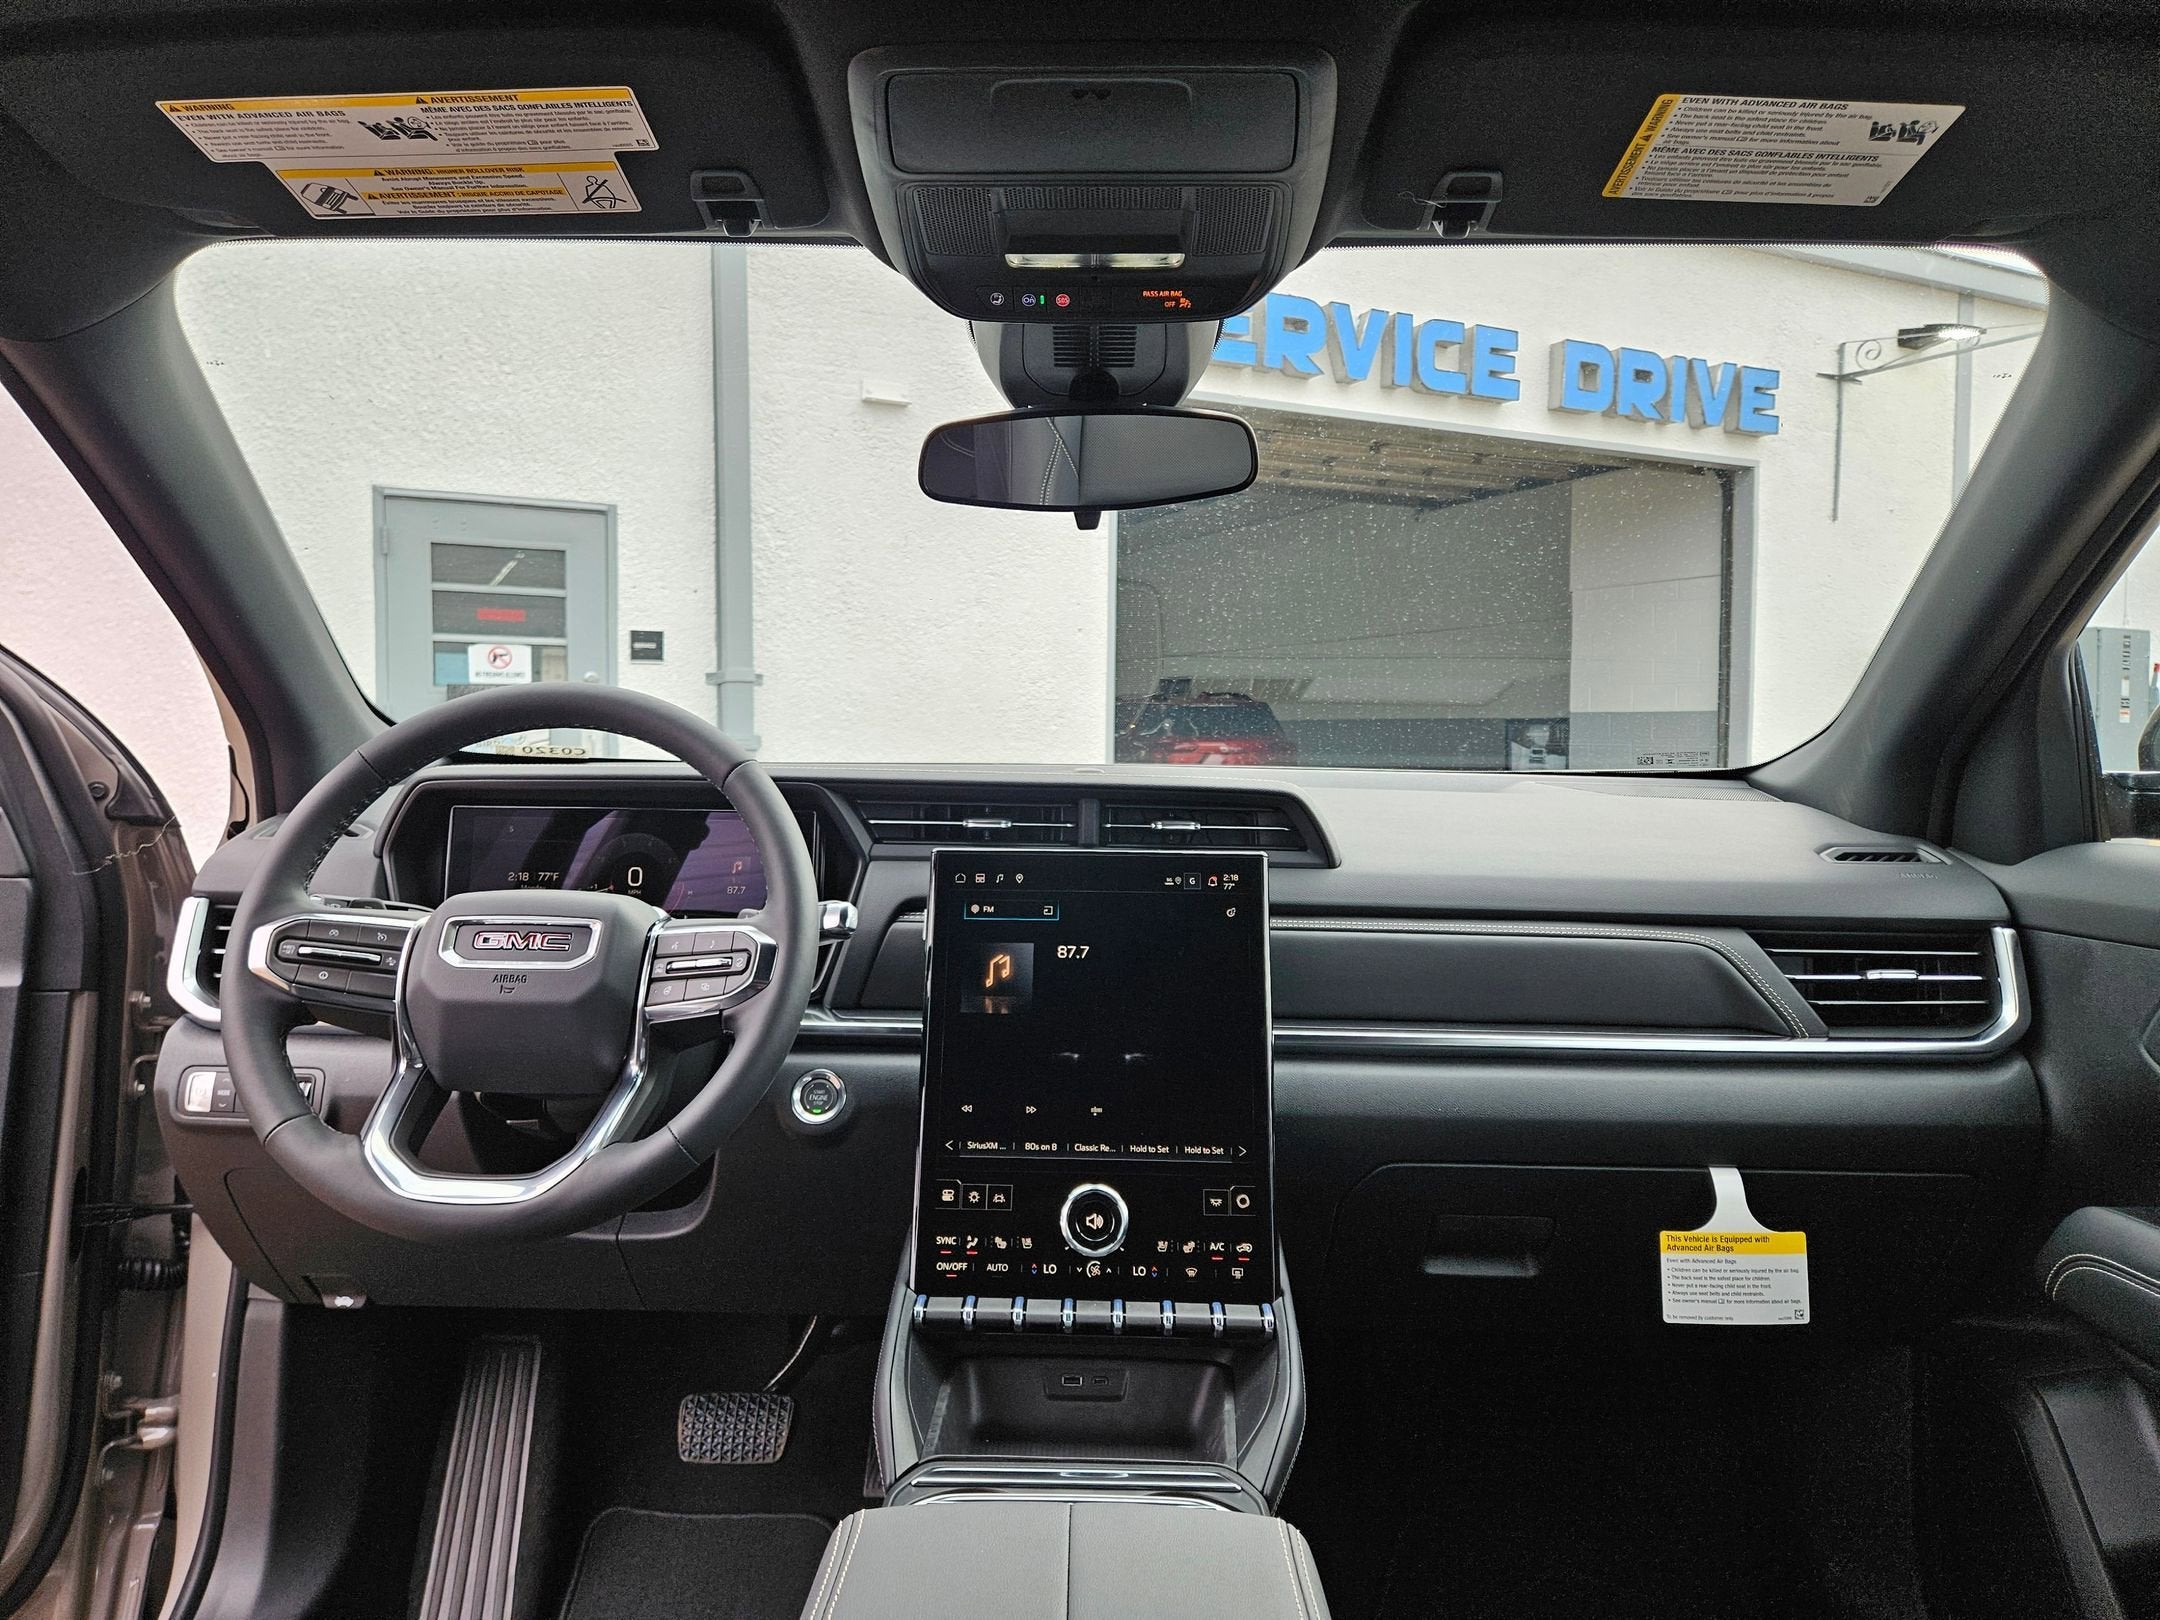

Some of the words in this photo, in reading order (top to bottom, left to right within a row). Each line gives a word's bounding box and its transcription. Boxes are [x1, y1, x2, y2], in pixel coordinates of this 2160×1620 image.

[430, 94, 519, 104] AVERTISSEMENT
[183, 103, 235, 112] WARNING
[1739, 100, 1797, 108] ADVANCED
[1753, 150, 1814, 158] GONFLABLES
[1814, 153, 1880, 161] INTELLIGENTS
[1211, 292, 1520, 402] ERVICE
[1549, 339, 1780, 435] DRIVE
[508, 872, 530, 881] 2:18
[727, 886, 746, 895] 87.7
[473, 930, 573, 951] GMC
[1057, 946, 1090, 959] 87.7
[492, 974, 527, 984] AIRBAG
[967, 1142, 998, 1150] SiriusXM
[1074, 1144, 1095, 1152] Classic
[1130, 1145, 1146, 1153] Hold
[1147, 1145, 1155, 1153] to
[1156, 1145, 1169, 1154] Set
[1184, 1146, 1201, 1154] Hold
[1210, 1147, 1224, 1155] Set
[936, 1237, 957, 1245] SYNC
[1719, 1236, 1752, 1244] Equipped
[1210, 1242, 1224, 1251] A/C
[1716, 1245, 1734, 1253] Bags
[936, 1262, 968, 1271] ON/OFF
[987, 1263, 1008, 1272] AUTO
[1043, 1264, 1057, 1274] LO
[1133, 1266, 1146, 1277] LO
